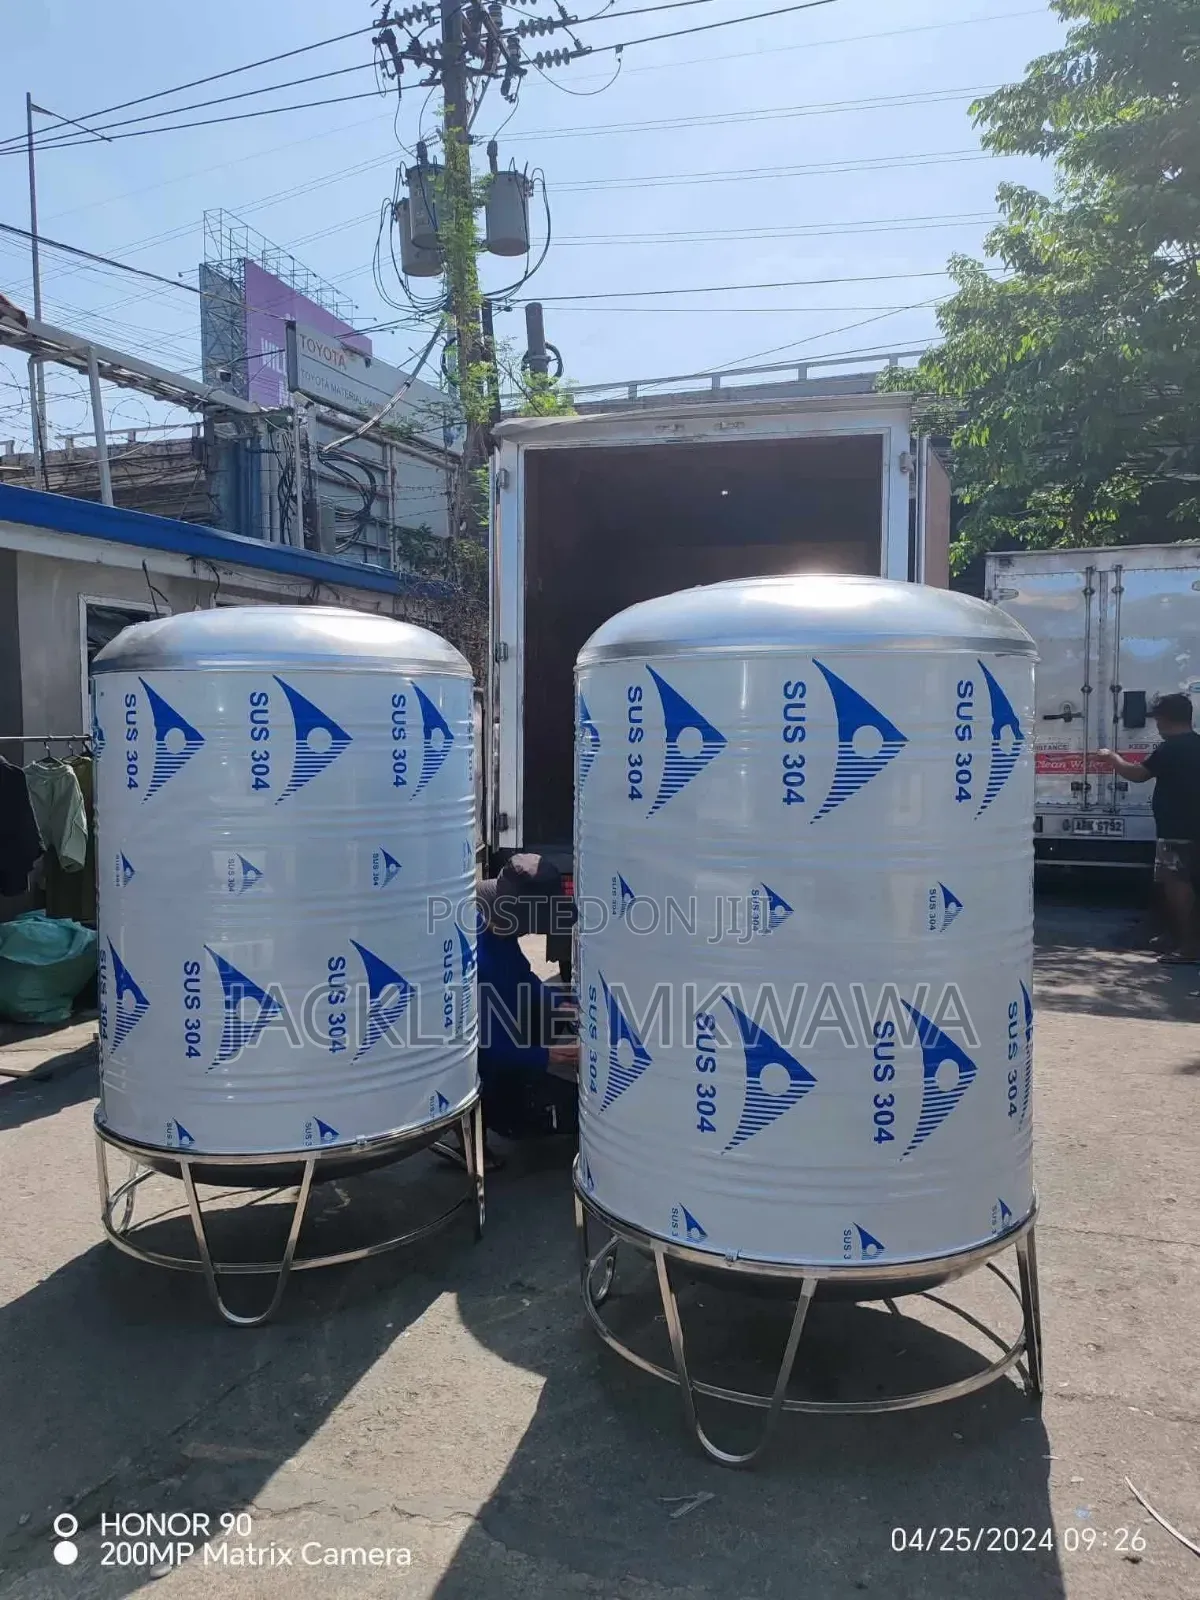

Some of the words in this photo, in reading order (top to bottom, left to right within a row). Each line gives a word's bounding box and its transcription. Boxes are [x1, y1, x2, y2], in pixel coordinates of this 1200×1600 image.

[300, 334, 347, 370] TOYOTA
[125, 693, 138, 742] SUS
[249, 691, 270, 742] SUS
[391, 693, 407, 742] SUS
[628, 686, 643, 743] SUS
[783, 681, 806, 743] SUS
[955, 680, 973, 742] SUS
[126, 750, 139, 790] 304
[250, 750, 271, 791] 304
[392, 749, 408, 788] 304
[628, 757, 643, 800] 304
[783, 756, 805, 805] 304
[955, 753, 973, 803] 304
[184, 961, 200, 1009] SUS
[328, 957, 346, 1005] SUS
[443, 939, 453, 988] SUS
[329, 1014, 347, 1055] 304
[444, 991, 454, 1029] 304
[588, 984, 597, 1040] SUS
[1007, 1001, 1018, 1061] SUS
[185, 1018, 201, 1059] 304
[696, 1013, 716, 1073] SUS
[873, 1021, 895, 1082] SUS
[589, 1053, 598, 1094] 304
[1007, 1072, 1018, 1118] 304
[696, 1084, 717, 1133] 304
[874, 1094, 895, 1144] 304
